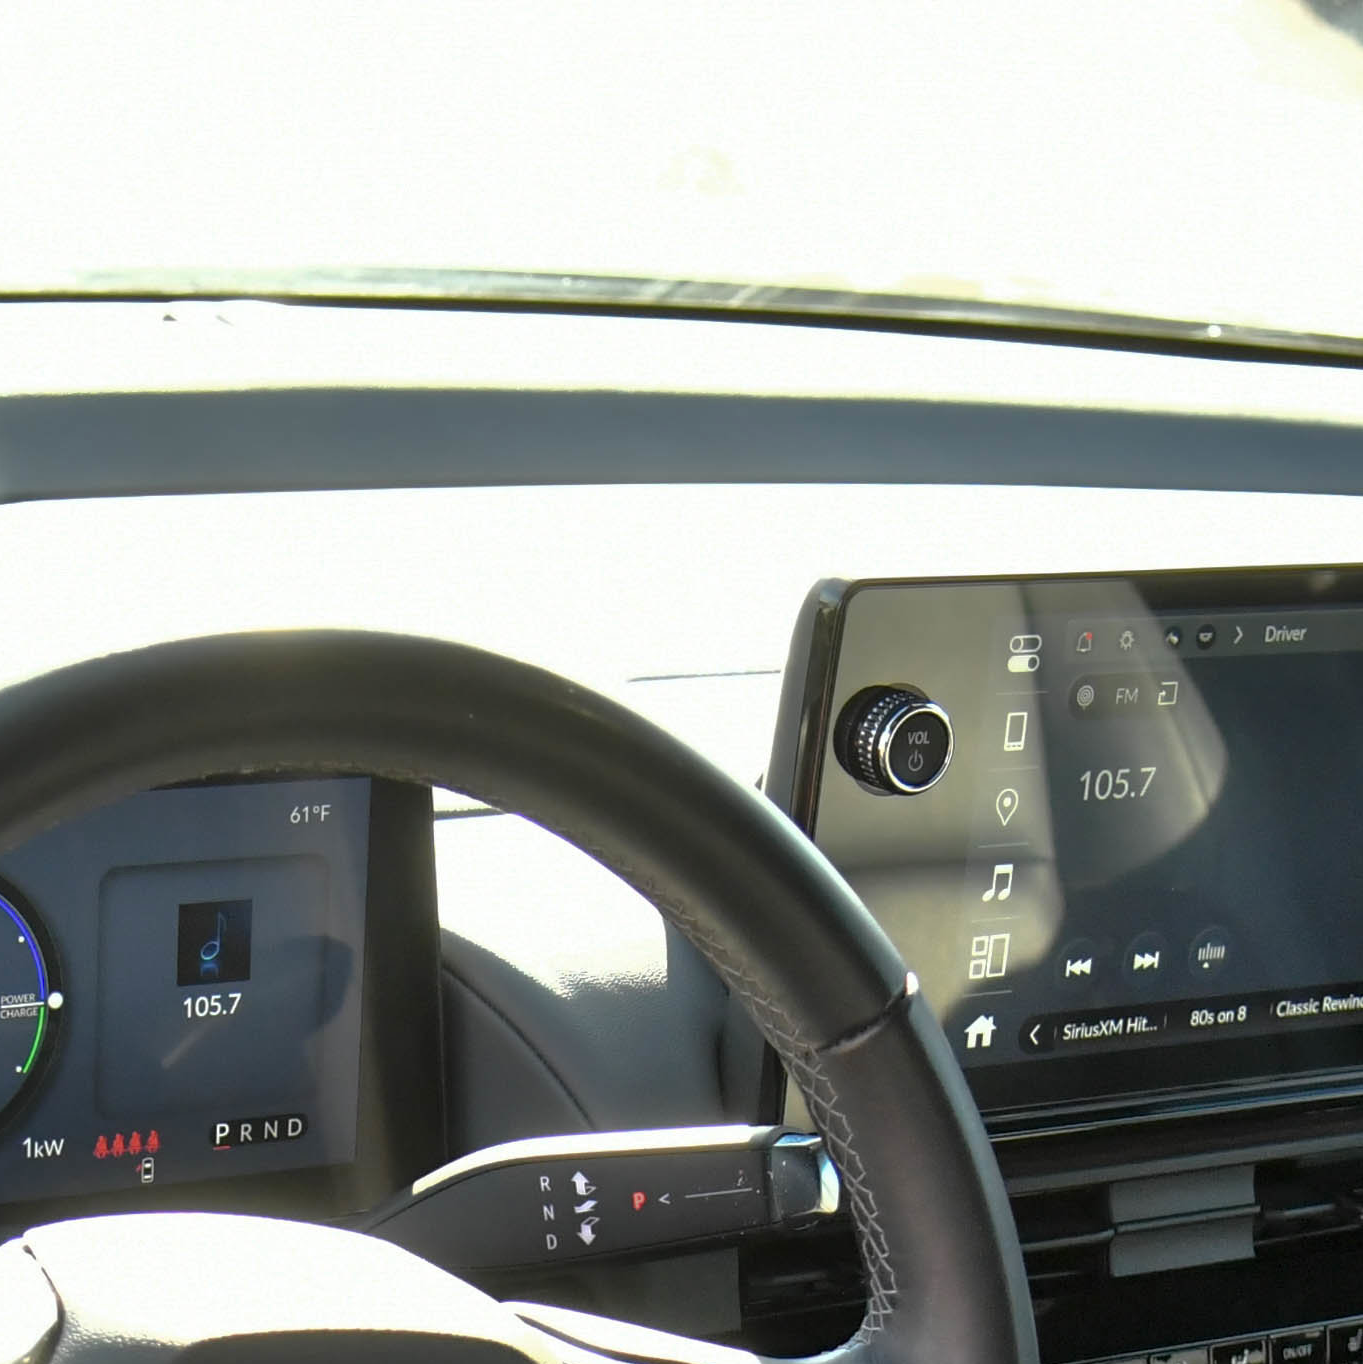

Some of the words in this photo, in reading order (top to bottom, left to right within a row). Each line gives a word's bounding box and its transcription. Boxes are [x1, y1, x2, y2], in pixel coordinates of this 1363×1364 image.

[1264, 624, 1308, 644] Driver
[1115, 687, 1139, 705] FM
[907, 731, 930, 745] VOL
[1079, 766, 1157, 801] 105.7
[0, 993, 36, 1005] POWER
[182, 992, 242, 1018] 105.7
[1275, 997, 1319, 1018] Classic
[0, 1007, 38, 1019] CHARGE
[1189, 1010, 1215, 1027] 80s
[1217, 1011, 1235, 1023] on
[1236, 1005, 1248, 1022] 8
[1062, 1019, 1123, 1041] SiriusXM
[215, 1122, 231, 1145] P
[240, 1123, 253, 1143] R
[264, 1119, 279, 1140] N
[287, 1117, 303, 1137] D
[22, 1136, 65, 1159] 1kW
[540, 1175, 552, 1193] R
[632, 1191, 647, 1211] P
[543, 1204, 555, 1222] N
[546, 1233, 558, 1251] D
